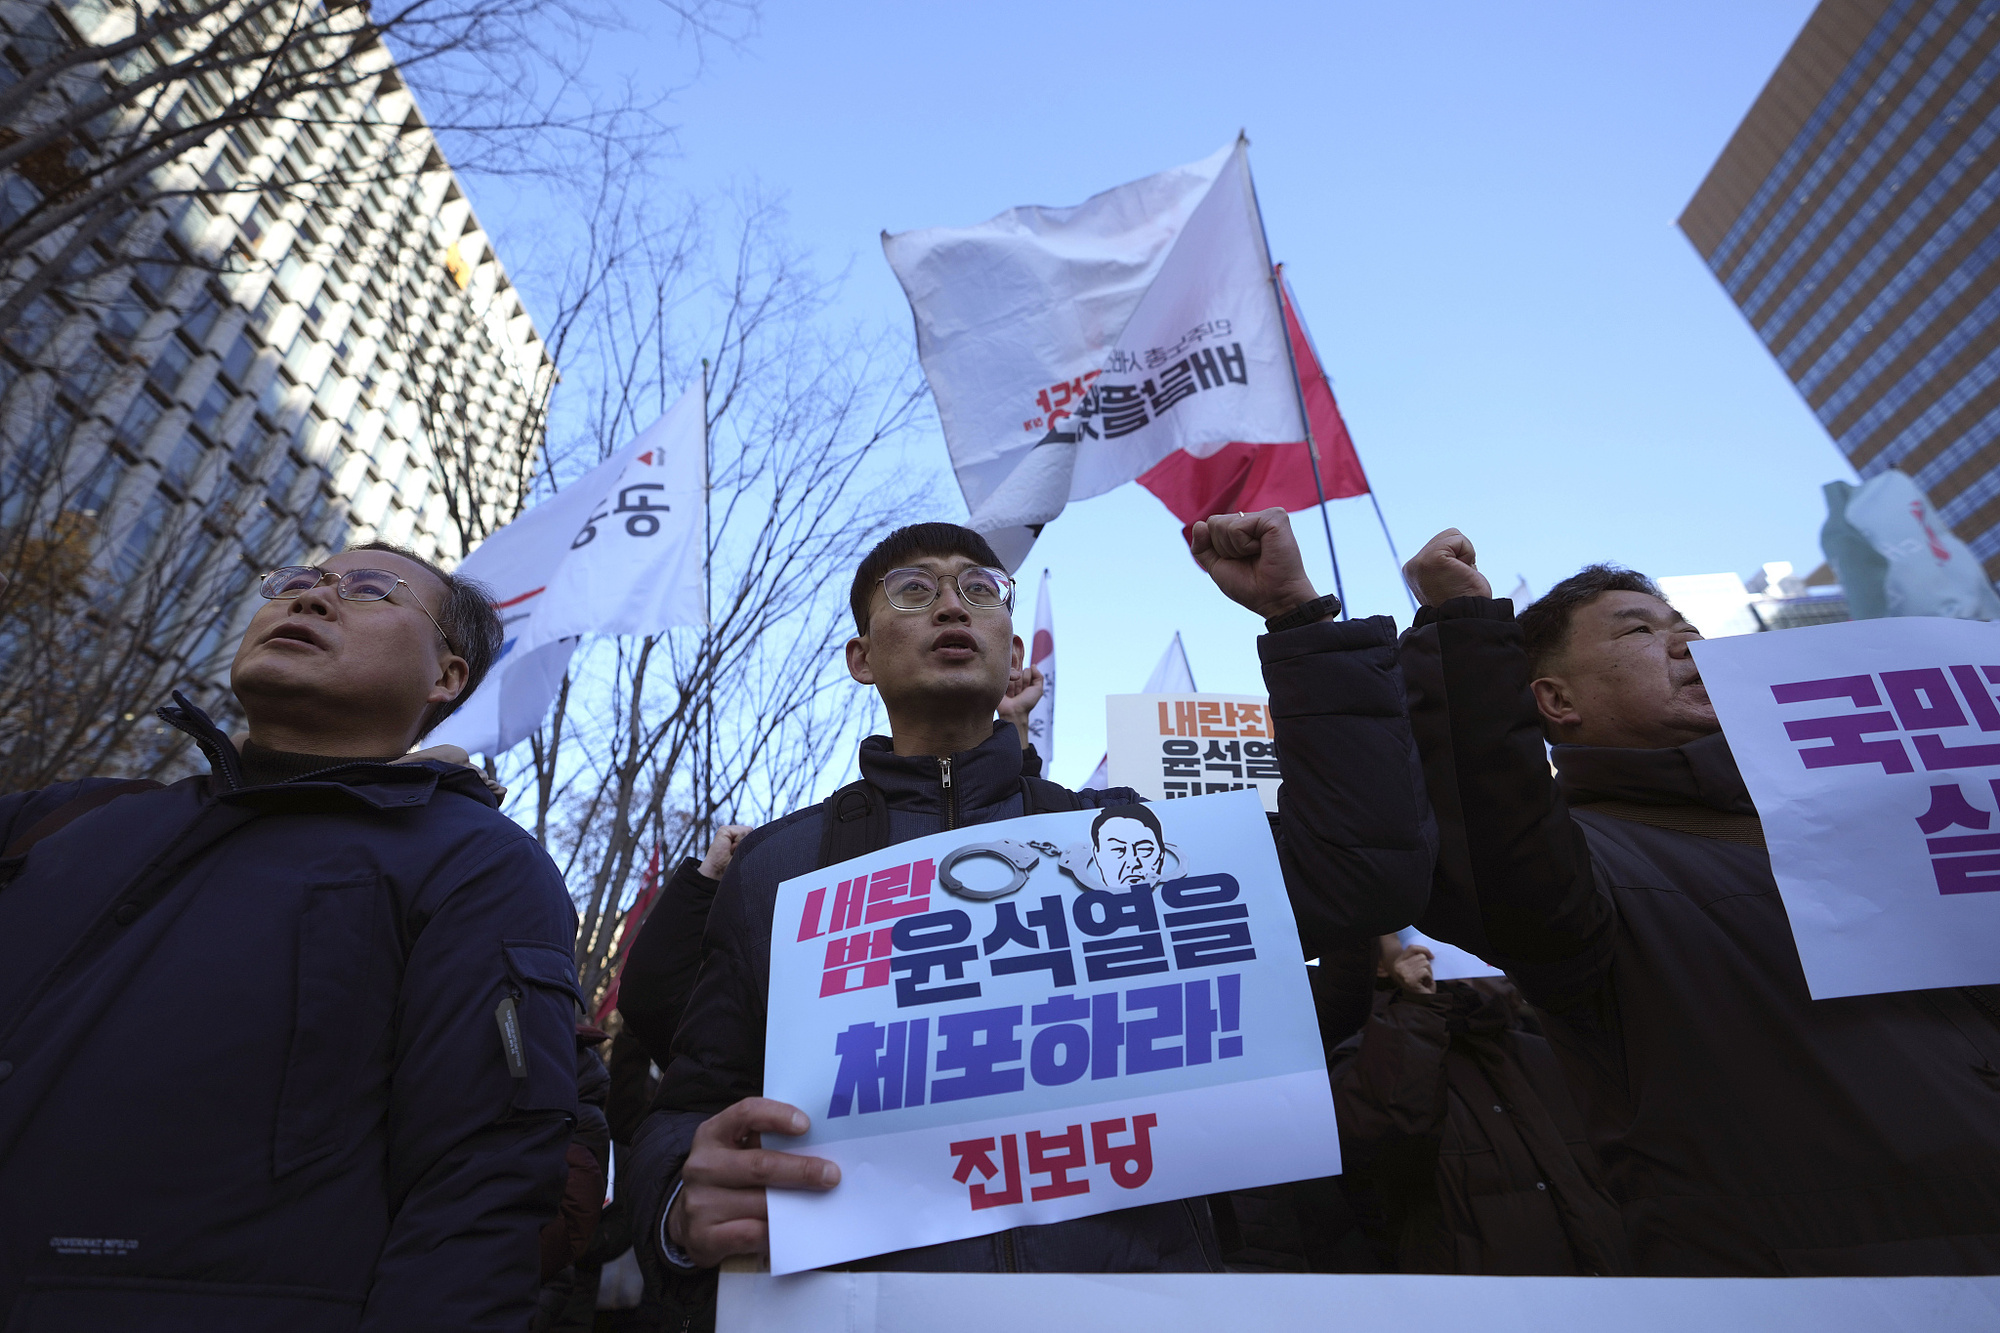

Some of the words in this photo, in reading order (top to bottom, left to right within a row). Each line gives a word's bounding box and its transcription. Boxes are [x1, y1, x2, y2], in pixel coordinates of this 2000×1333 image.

[1157, 701, 1275, 739] 내란죄
[1161, 739, 1283, 780] 윤석열
[1769, 664, 2000, 775] 국민
[796, 857, 937, 943] 내란
[889, 872, 1257, 1009] 윤석열을
[826, 973, 1244, 1120] 체포하라!
[949, 1112, 1158, 1211] 진보당
